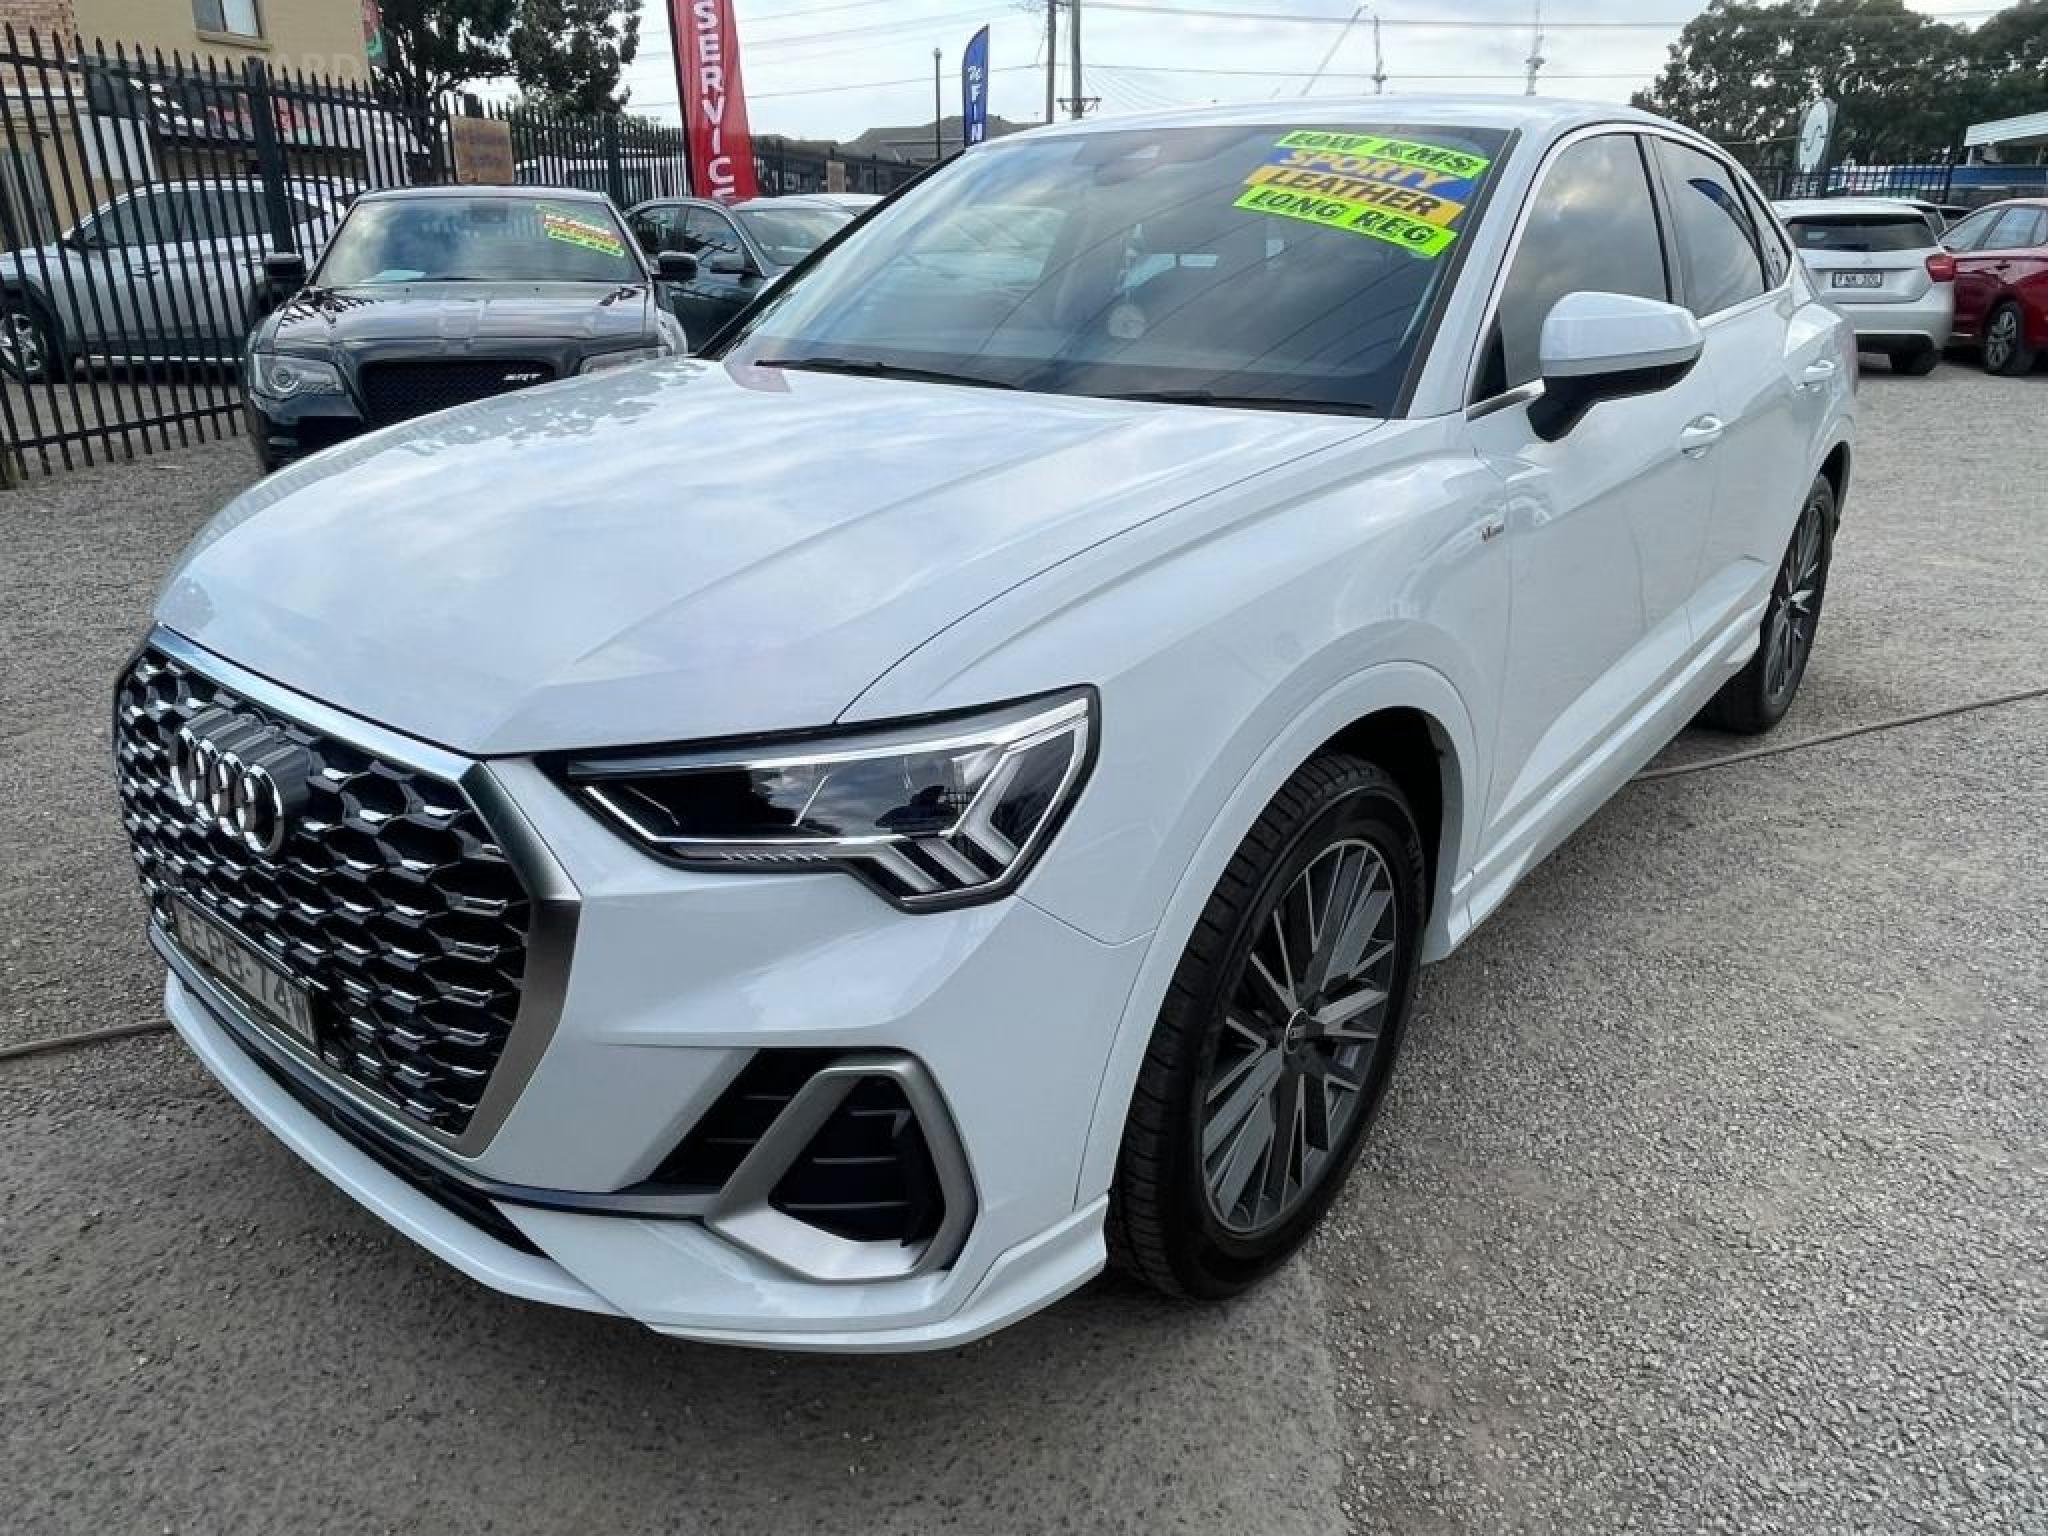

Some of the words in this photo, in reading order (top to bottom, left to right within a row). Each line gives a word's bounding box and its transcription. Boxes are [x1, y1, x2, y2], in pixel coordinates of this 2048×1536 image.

[1281, 149, 1459, 190] SPORTY
[1285, 132, 1369, 151] LOW
[1373, 142, 1481, 172] KMS
[1264, 168, 1442, 217] LEATHER
[1248, 188, 1348, 218] LONG
[1352, 210, 1436, 243] REG
